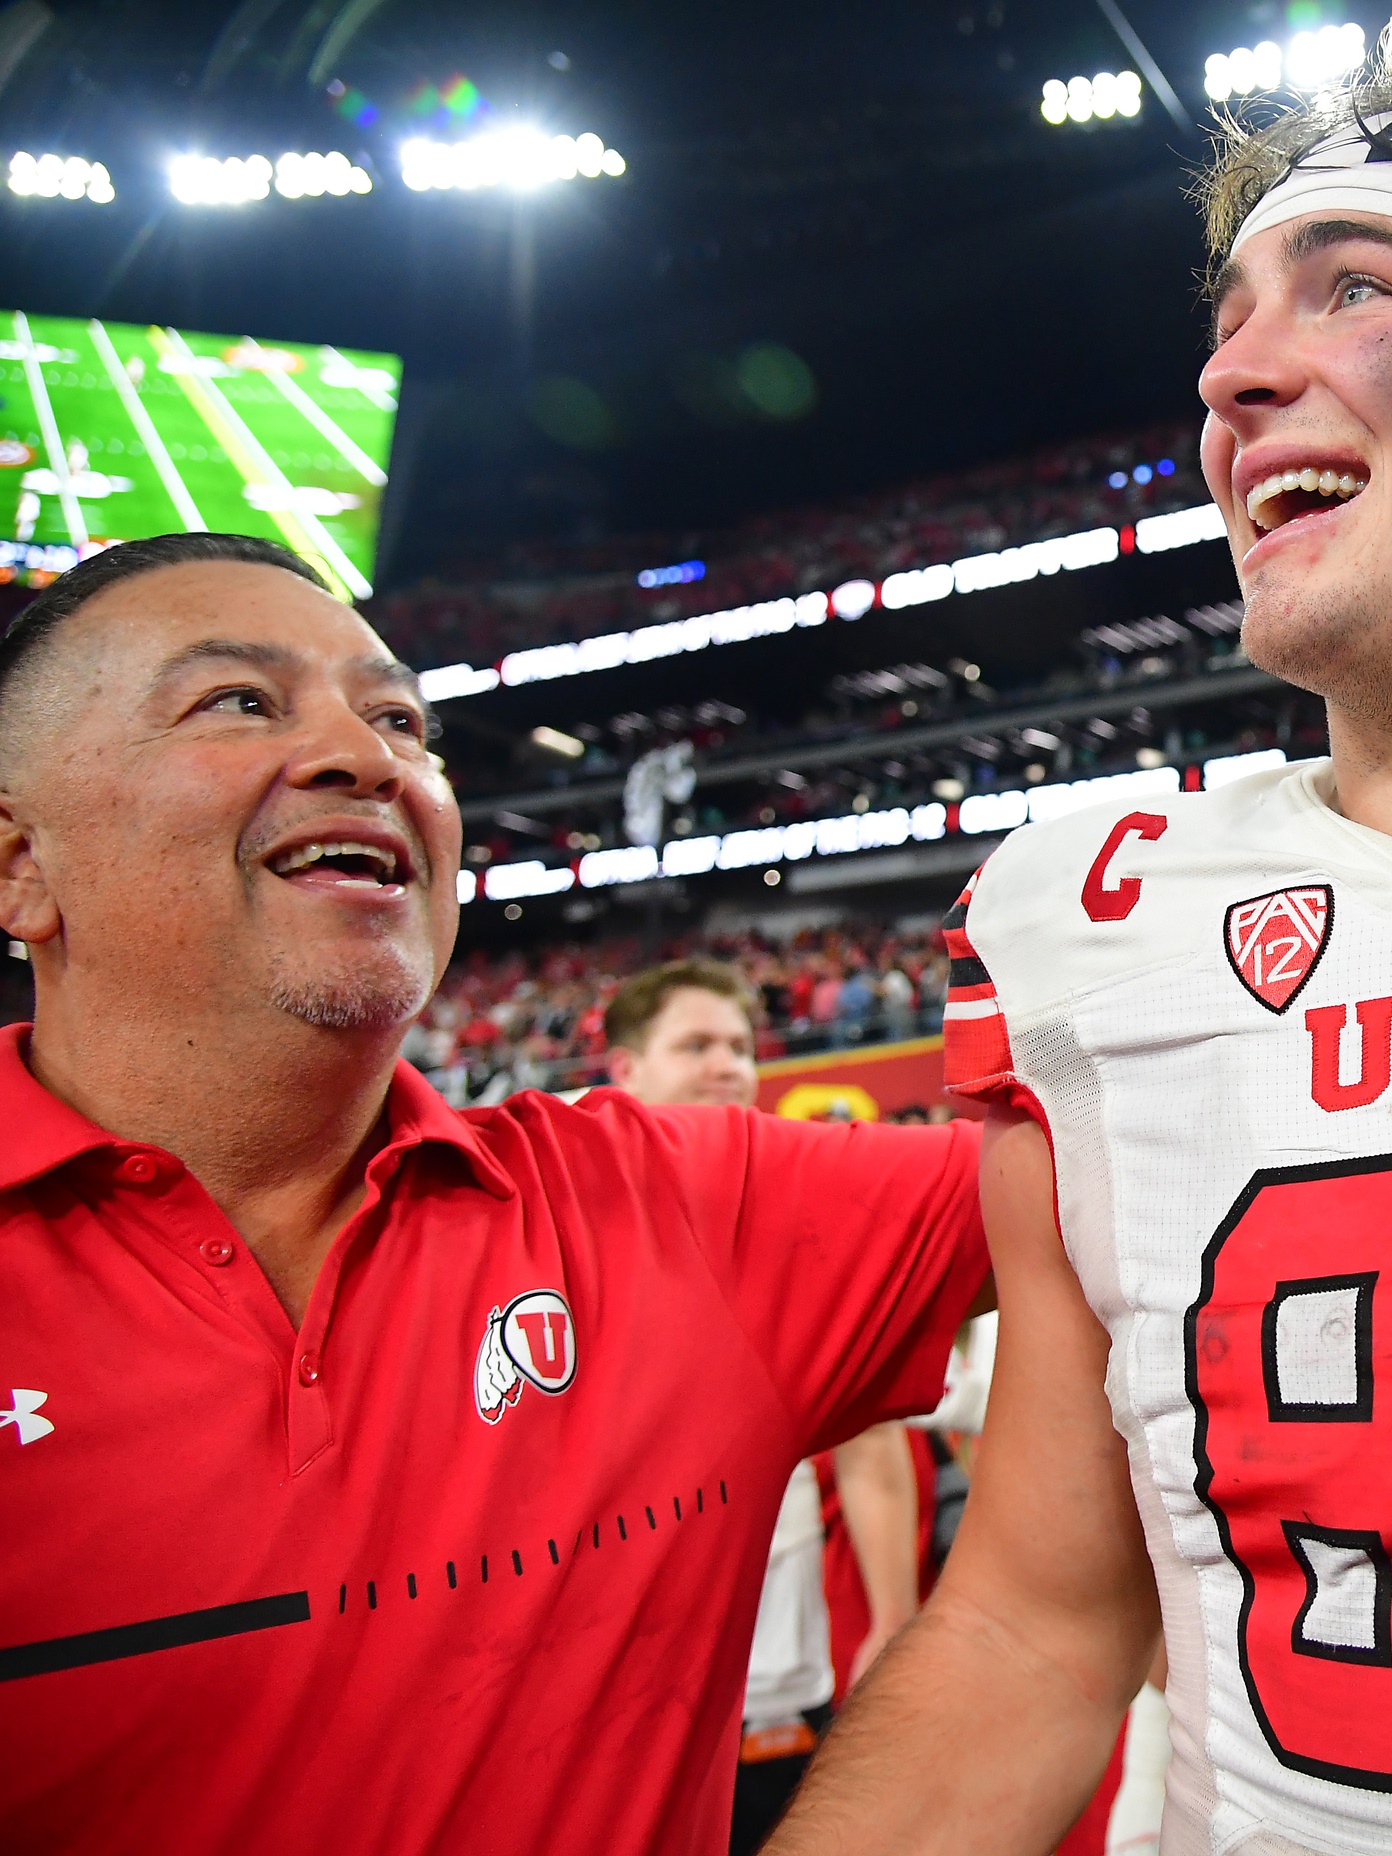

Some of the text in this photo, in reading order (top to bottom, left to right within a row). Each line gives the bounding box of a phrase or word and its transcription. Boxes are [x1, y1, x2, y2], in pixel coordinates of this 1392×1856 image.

[1081, 811, 1168, 922] C
[1229, 889, 1327, 969] PAC
[1253, 936, 1303, 987] 12
[515, 1311, 568, 1380] U
